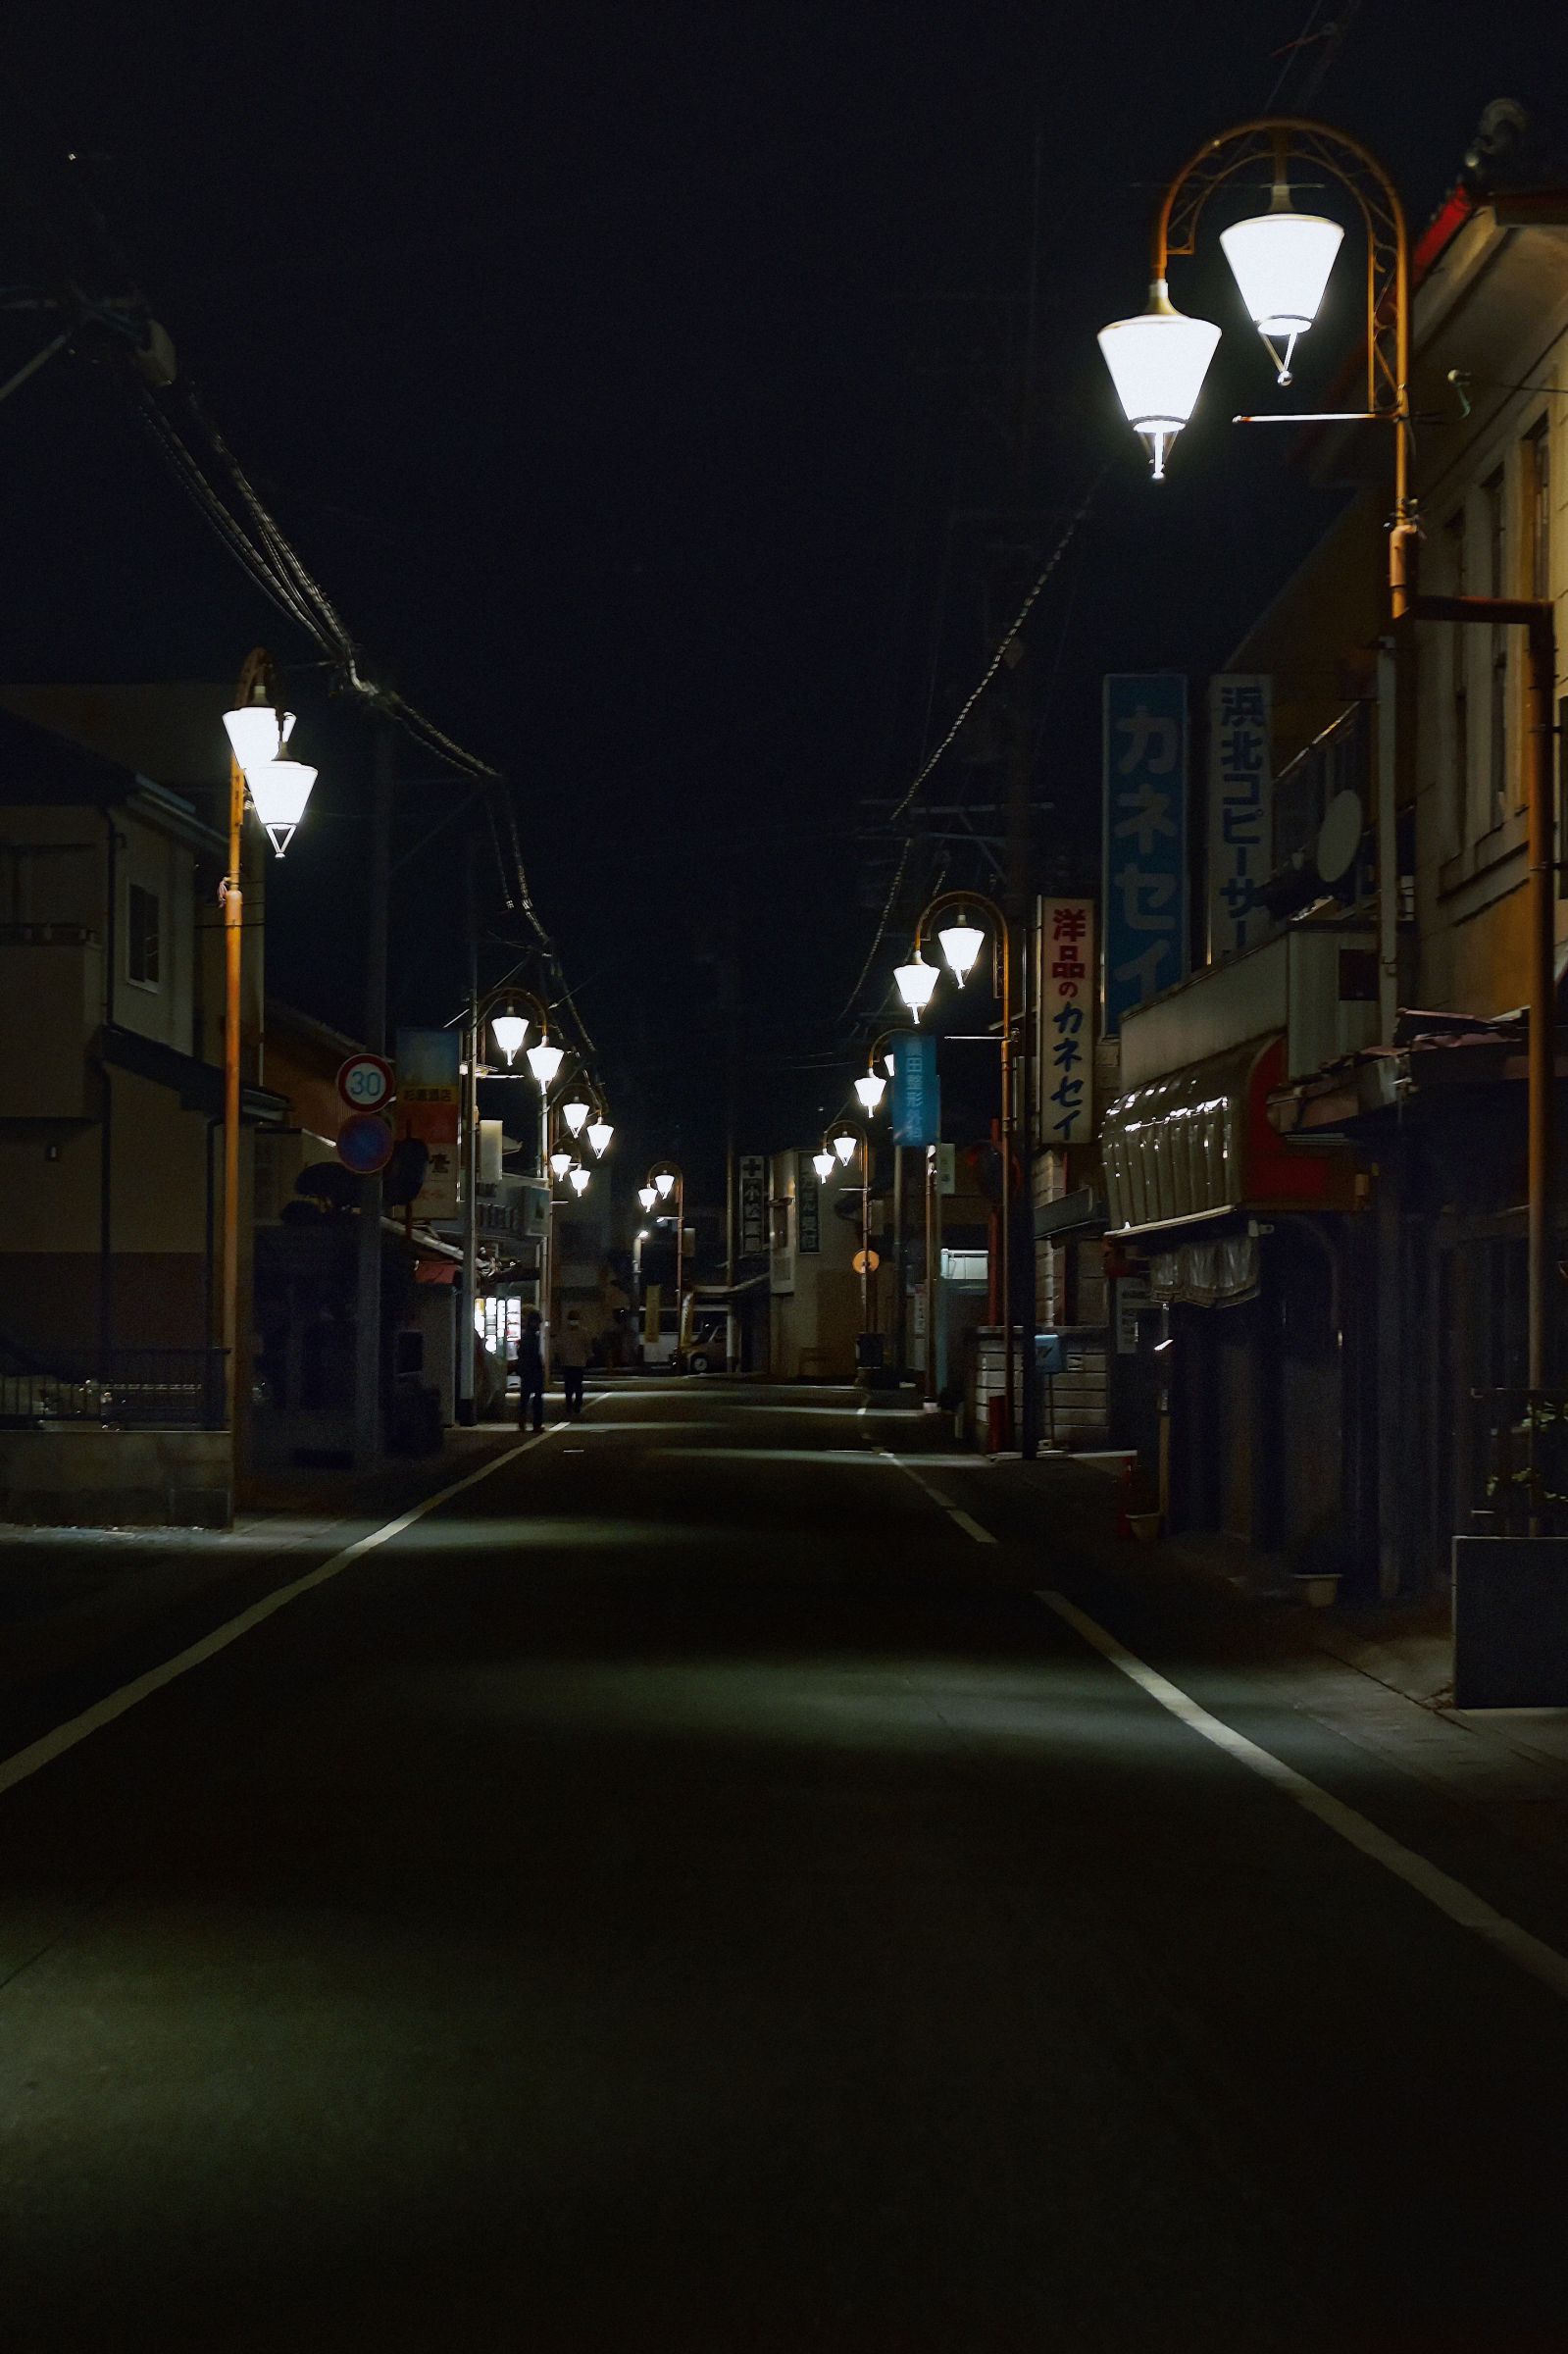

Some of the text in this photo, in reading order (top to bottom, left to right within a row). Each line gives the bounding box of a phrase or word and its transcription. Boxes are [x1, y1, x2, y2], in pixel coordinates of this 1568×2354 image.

[1114, 705, 1178, 1002] カネセイ
[1220, 687, 1267, 954] 浜北コピーサー
[351, 1070, 381, 1097] 30
[1051, 908, 1087, 1141] 洋品のカネセイ
